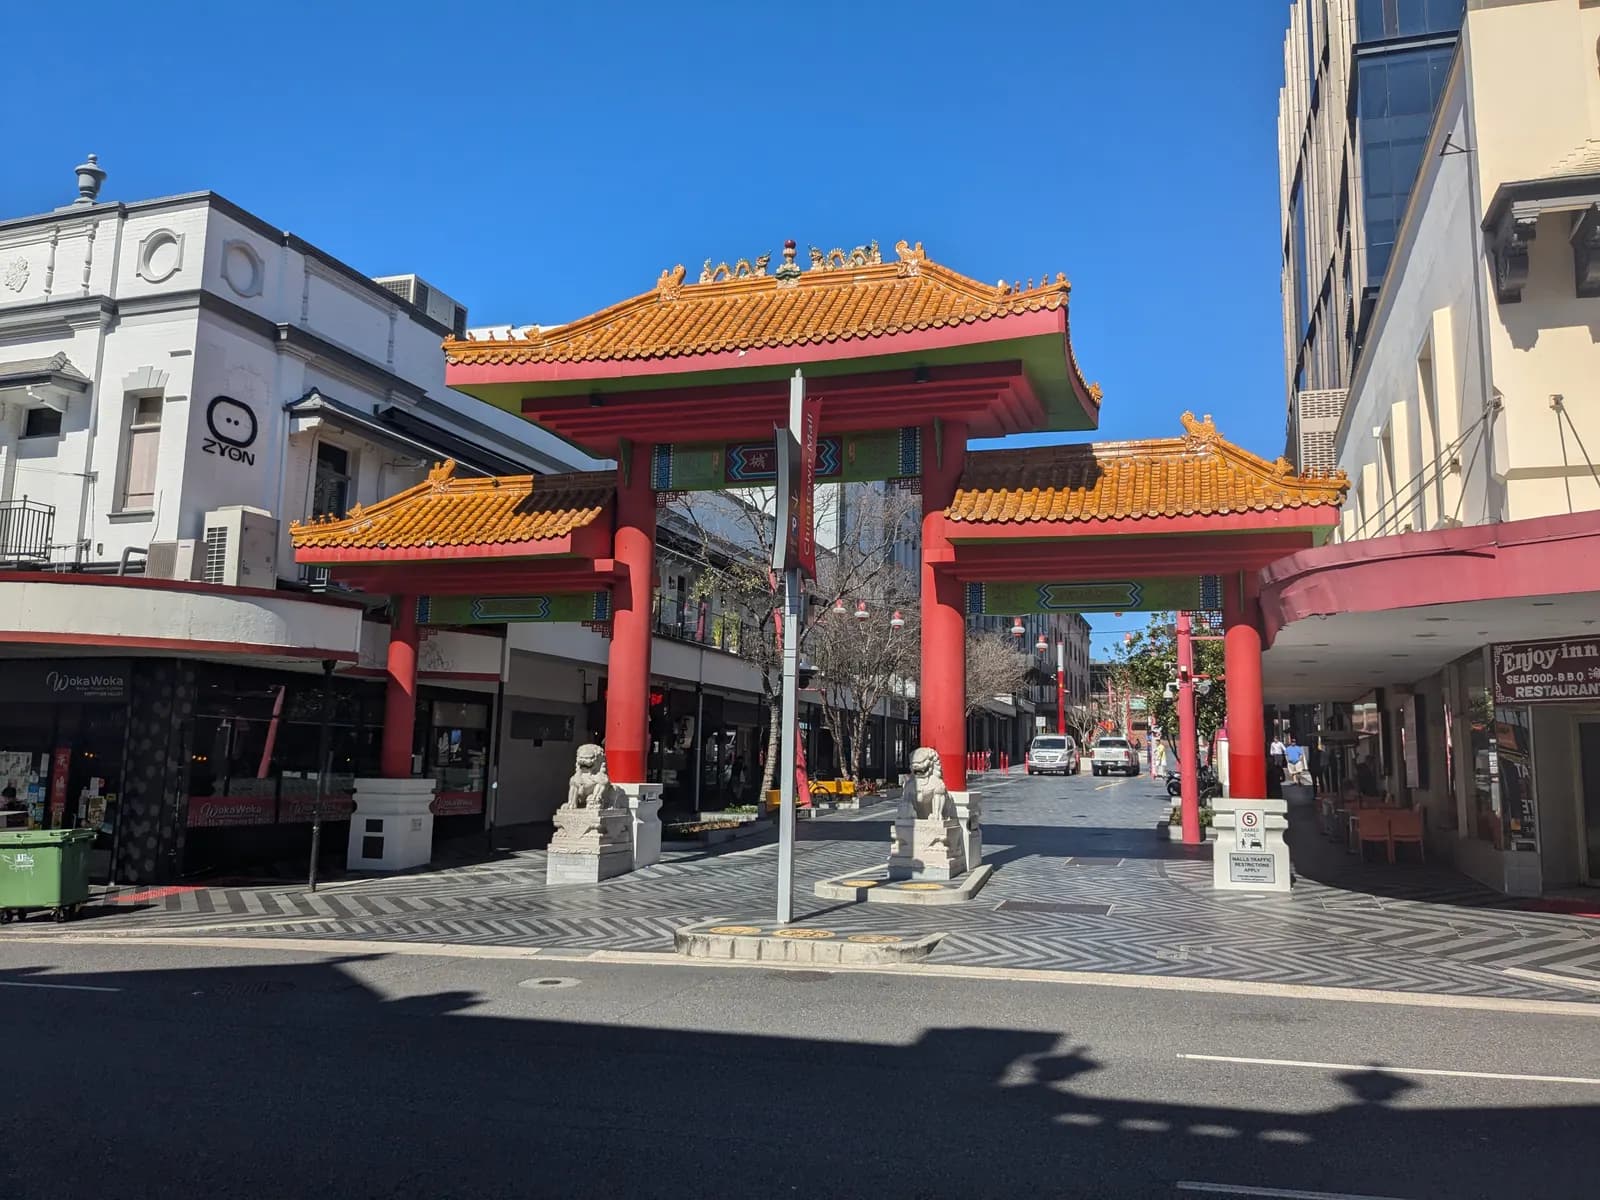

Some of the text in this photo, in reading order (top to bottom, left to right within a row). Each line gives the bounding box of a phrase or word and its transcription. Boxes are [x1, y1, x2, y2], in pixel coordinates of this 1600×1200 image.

[202, 437, 256, 466] ZYON
[803, 412, 814, 556] Chinatown Mall
[1515, 683, 1600, 698] RESTAURAN
[1246, 815, 1254, 824] 5
